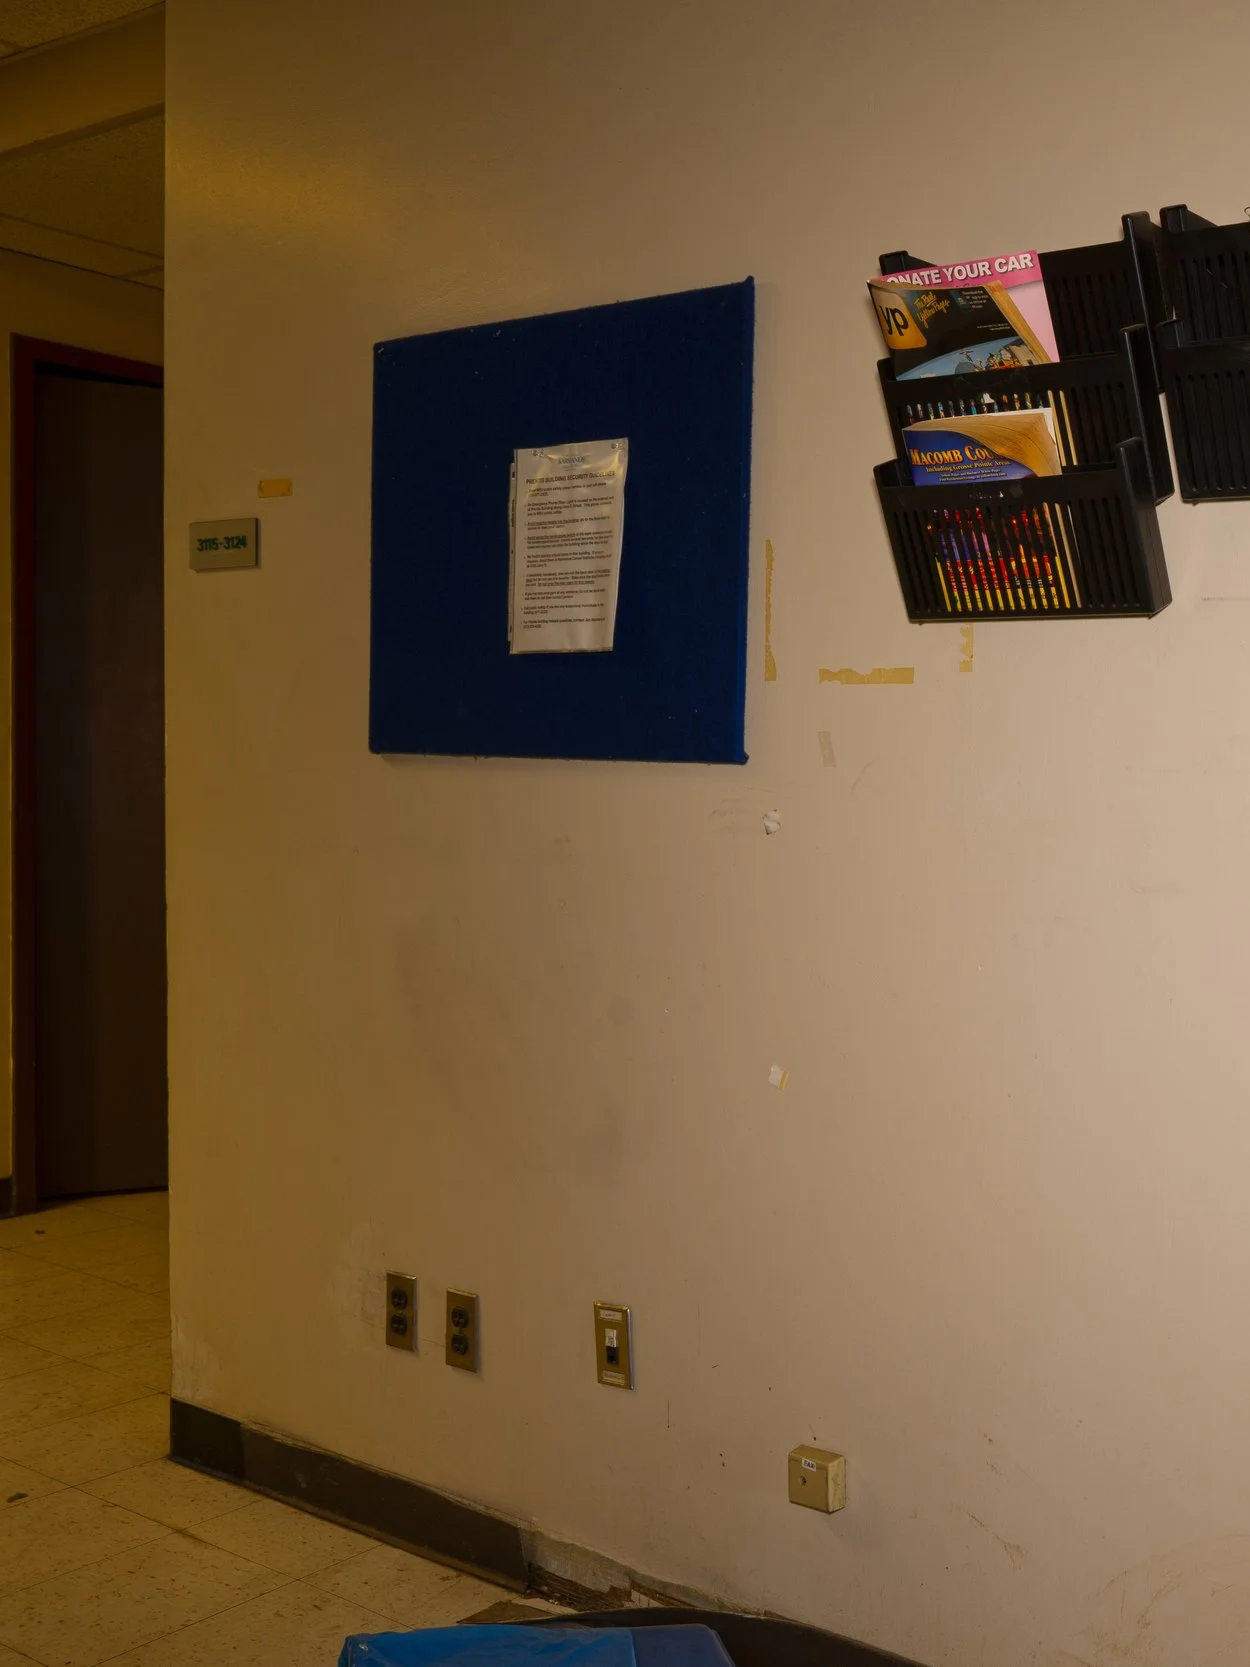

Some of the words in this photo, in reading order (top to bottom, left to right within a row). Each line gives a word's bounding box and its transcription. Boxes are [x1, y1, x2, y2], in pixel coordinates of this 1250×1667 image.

[943, 261, 991, 282] YOUR
[993, 252, 1034, 274] CAR
[879, 305, 910, 337] yp
[909, 448, 963, 465] MACOMB
[803, 1459, 816, 1469] FAX
